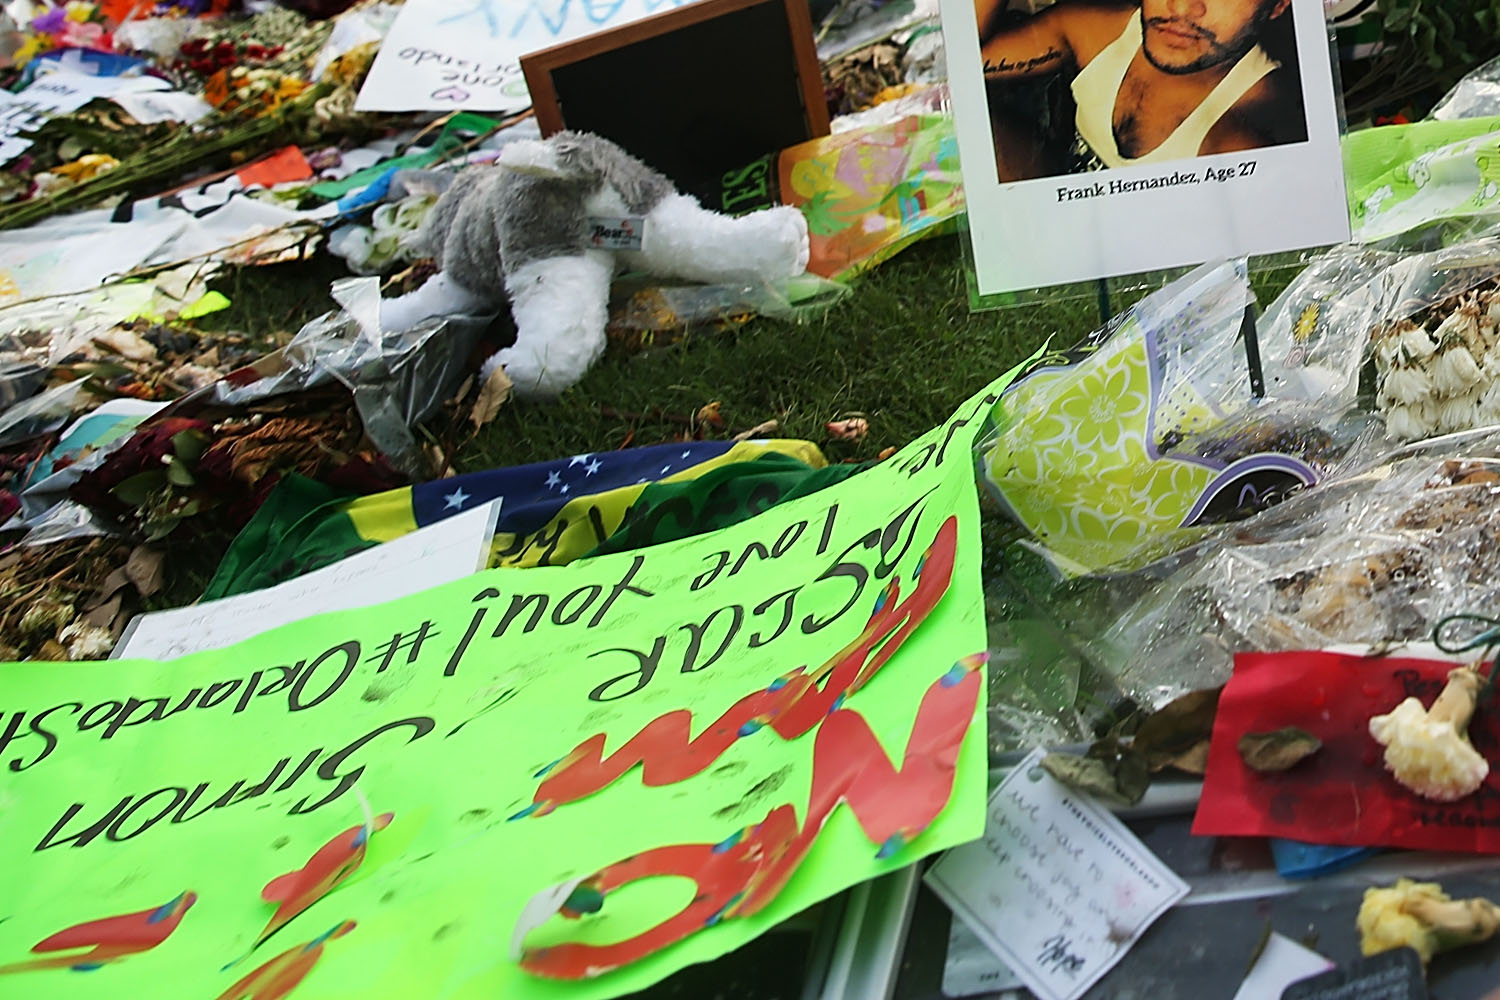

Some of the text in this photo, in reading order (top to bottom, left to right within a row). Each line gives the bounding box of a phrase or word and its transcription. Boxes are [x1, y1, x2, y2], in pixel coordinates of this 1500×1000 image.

[722, 160, 770, 217] ES
[1057, 161, 1257, 202] Frank Hernandez, Age 27
[689, 502, 838, 592] love
[0, 619, 441, 772] #OrlandoSt
